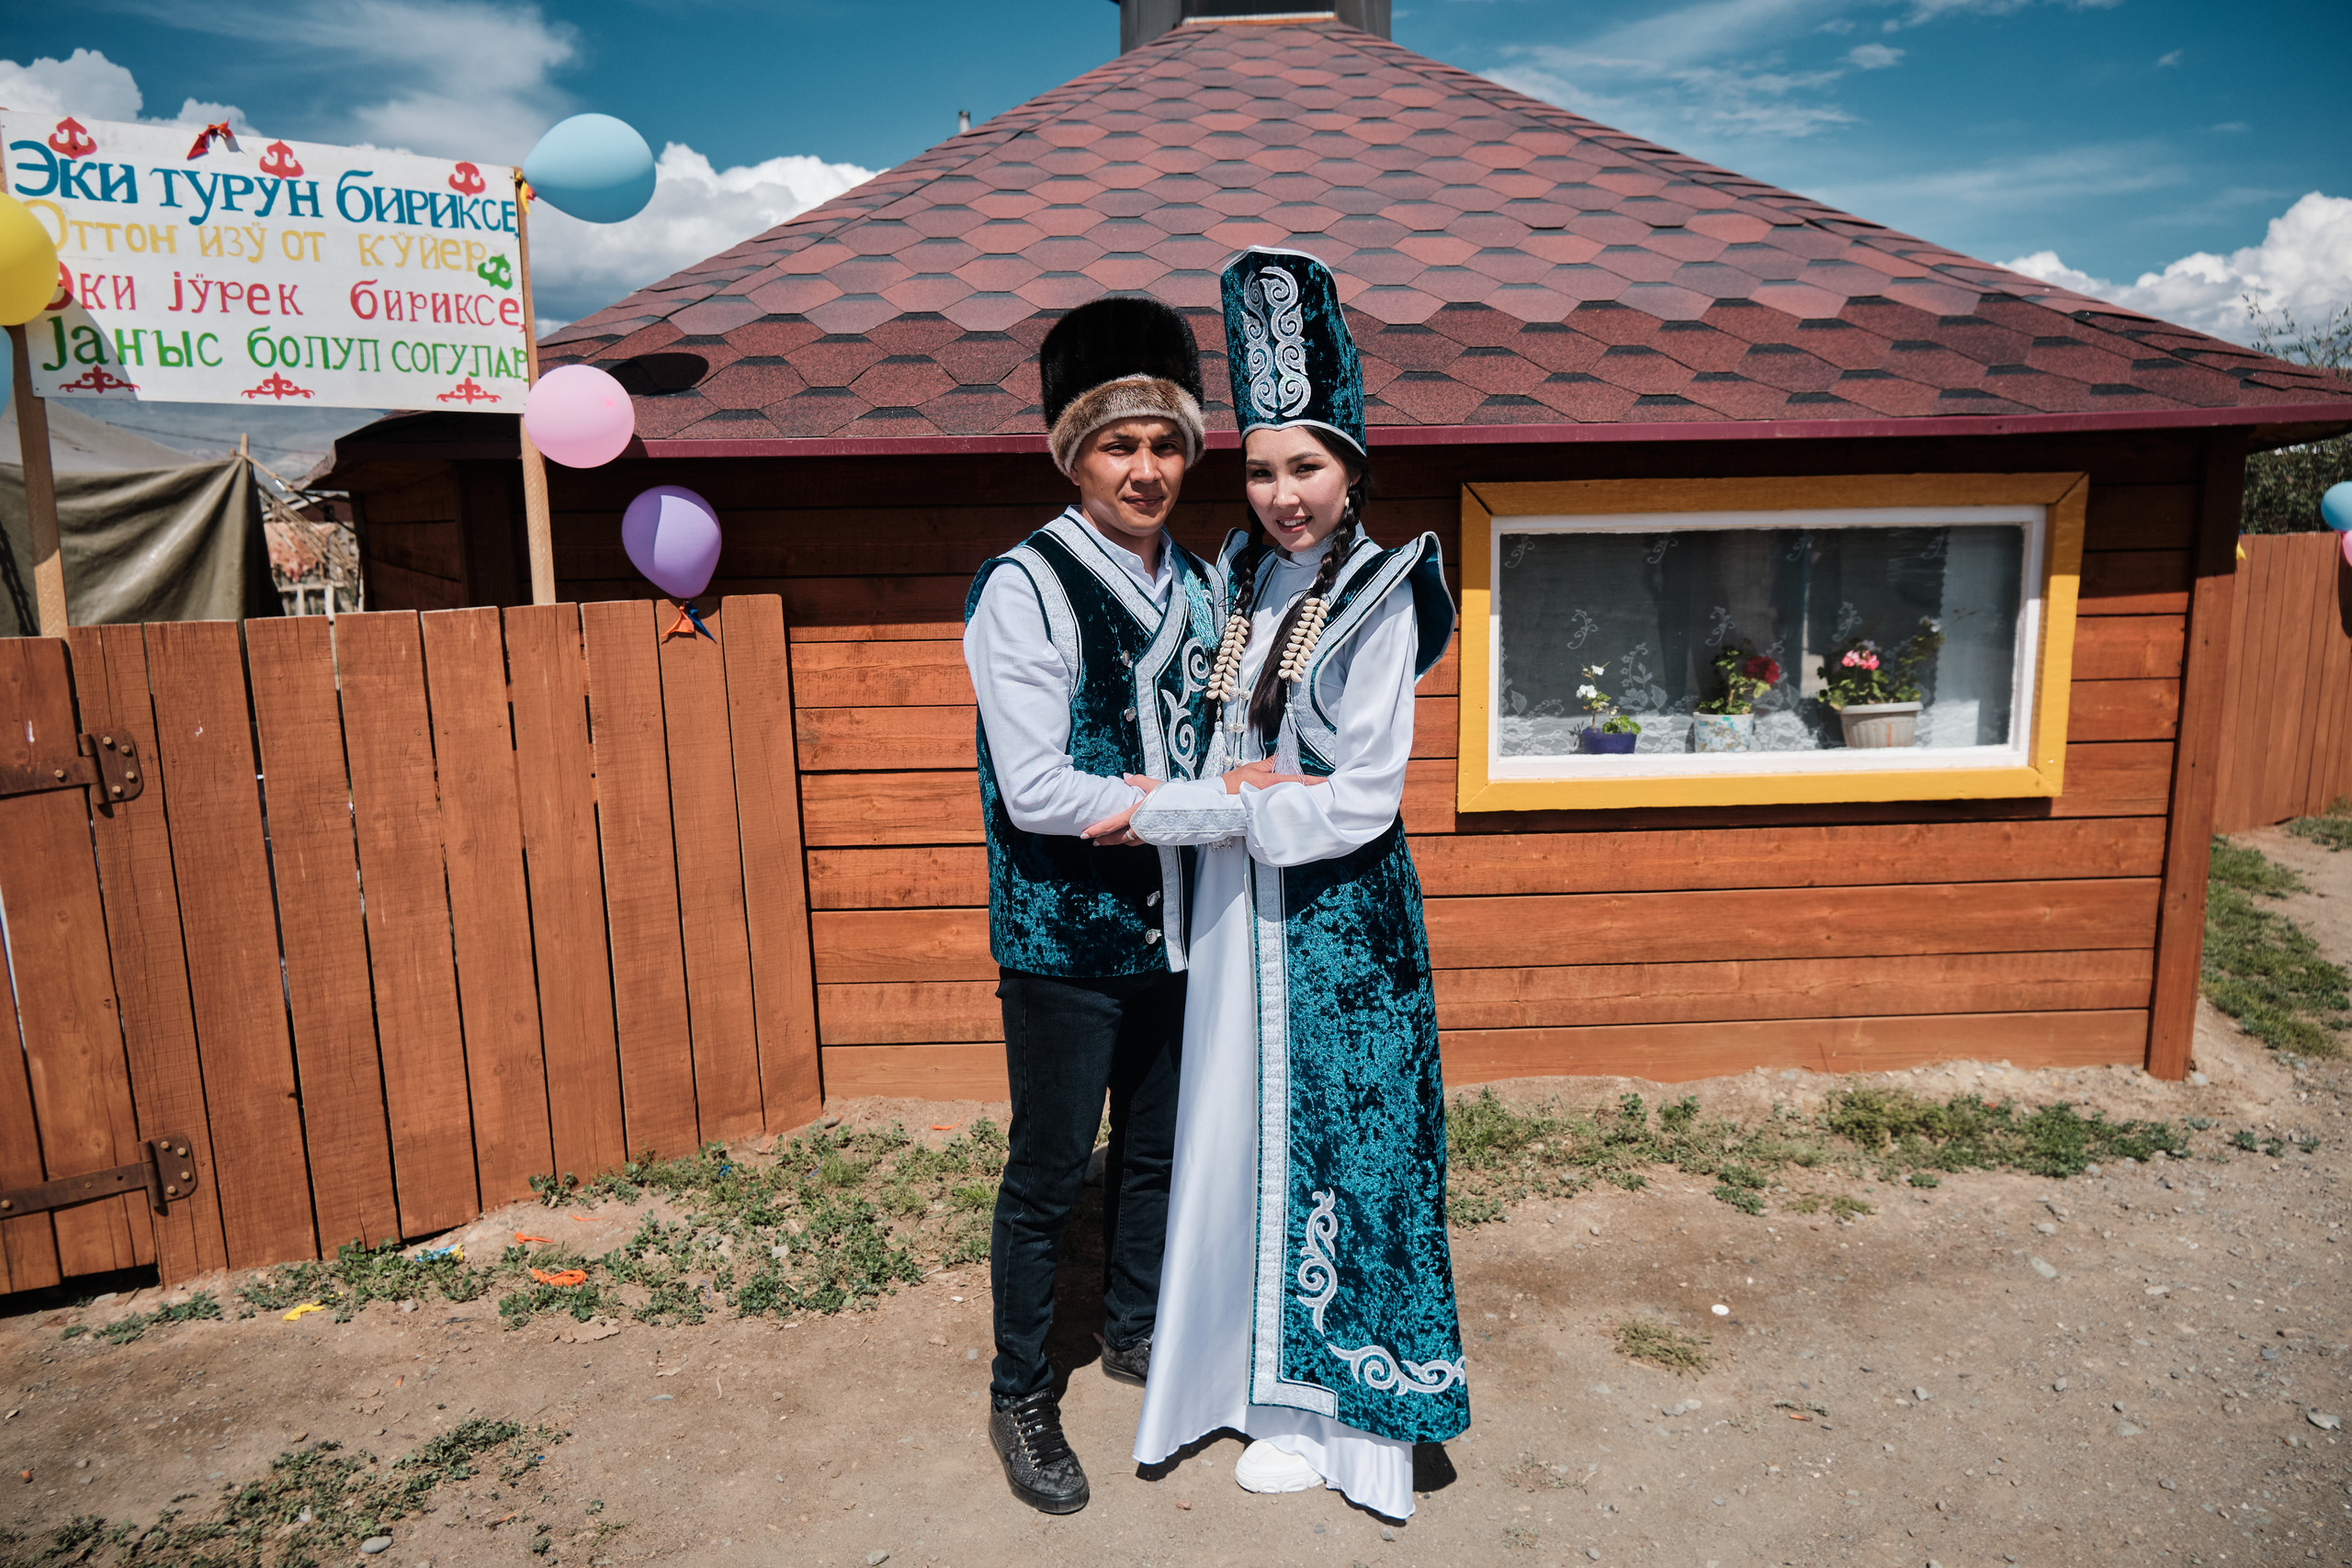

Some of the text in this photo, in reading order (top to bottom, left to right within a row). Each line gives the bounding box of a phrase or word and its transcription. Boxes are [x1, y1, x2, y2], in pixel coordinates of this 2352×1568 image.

[9, 140, 139, 204] Эки
[149, 167, 323, 226] турун
[281, 229, 326, 263] от
[247, 325, 381, 372] болуп
